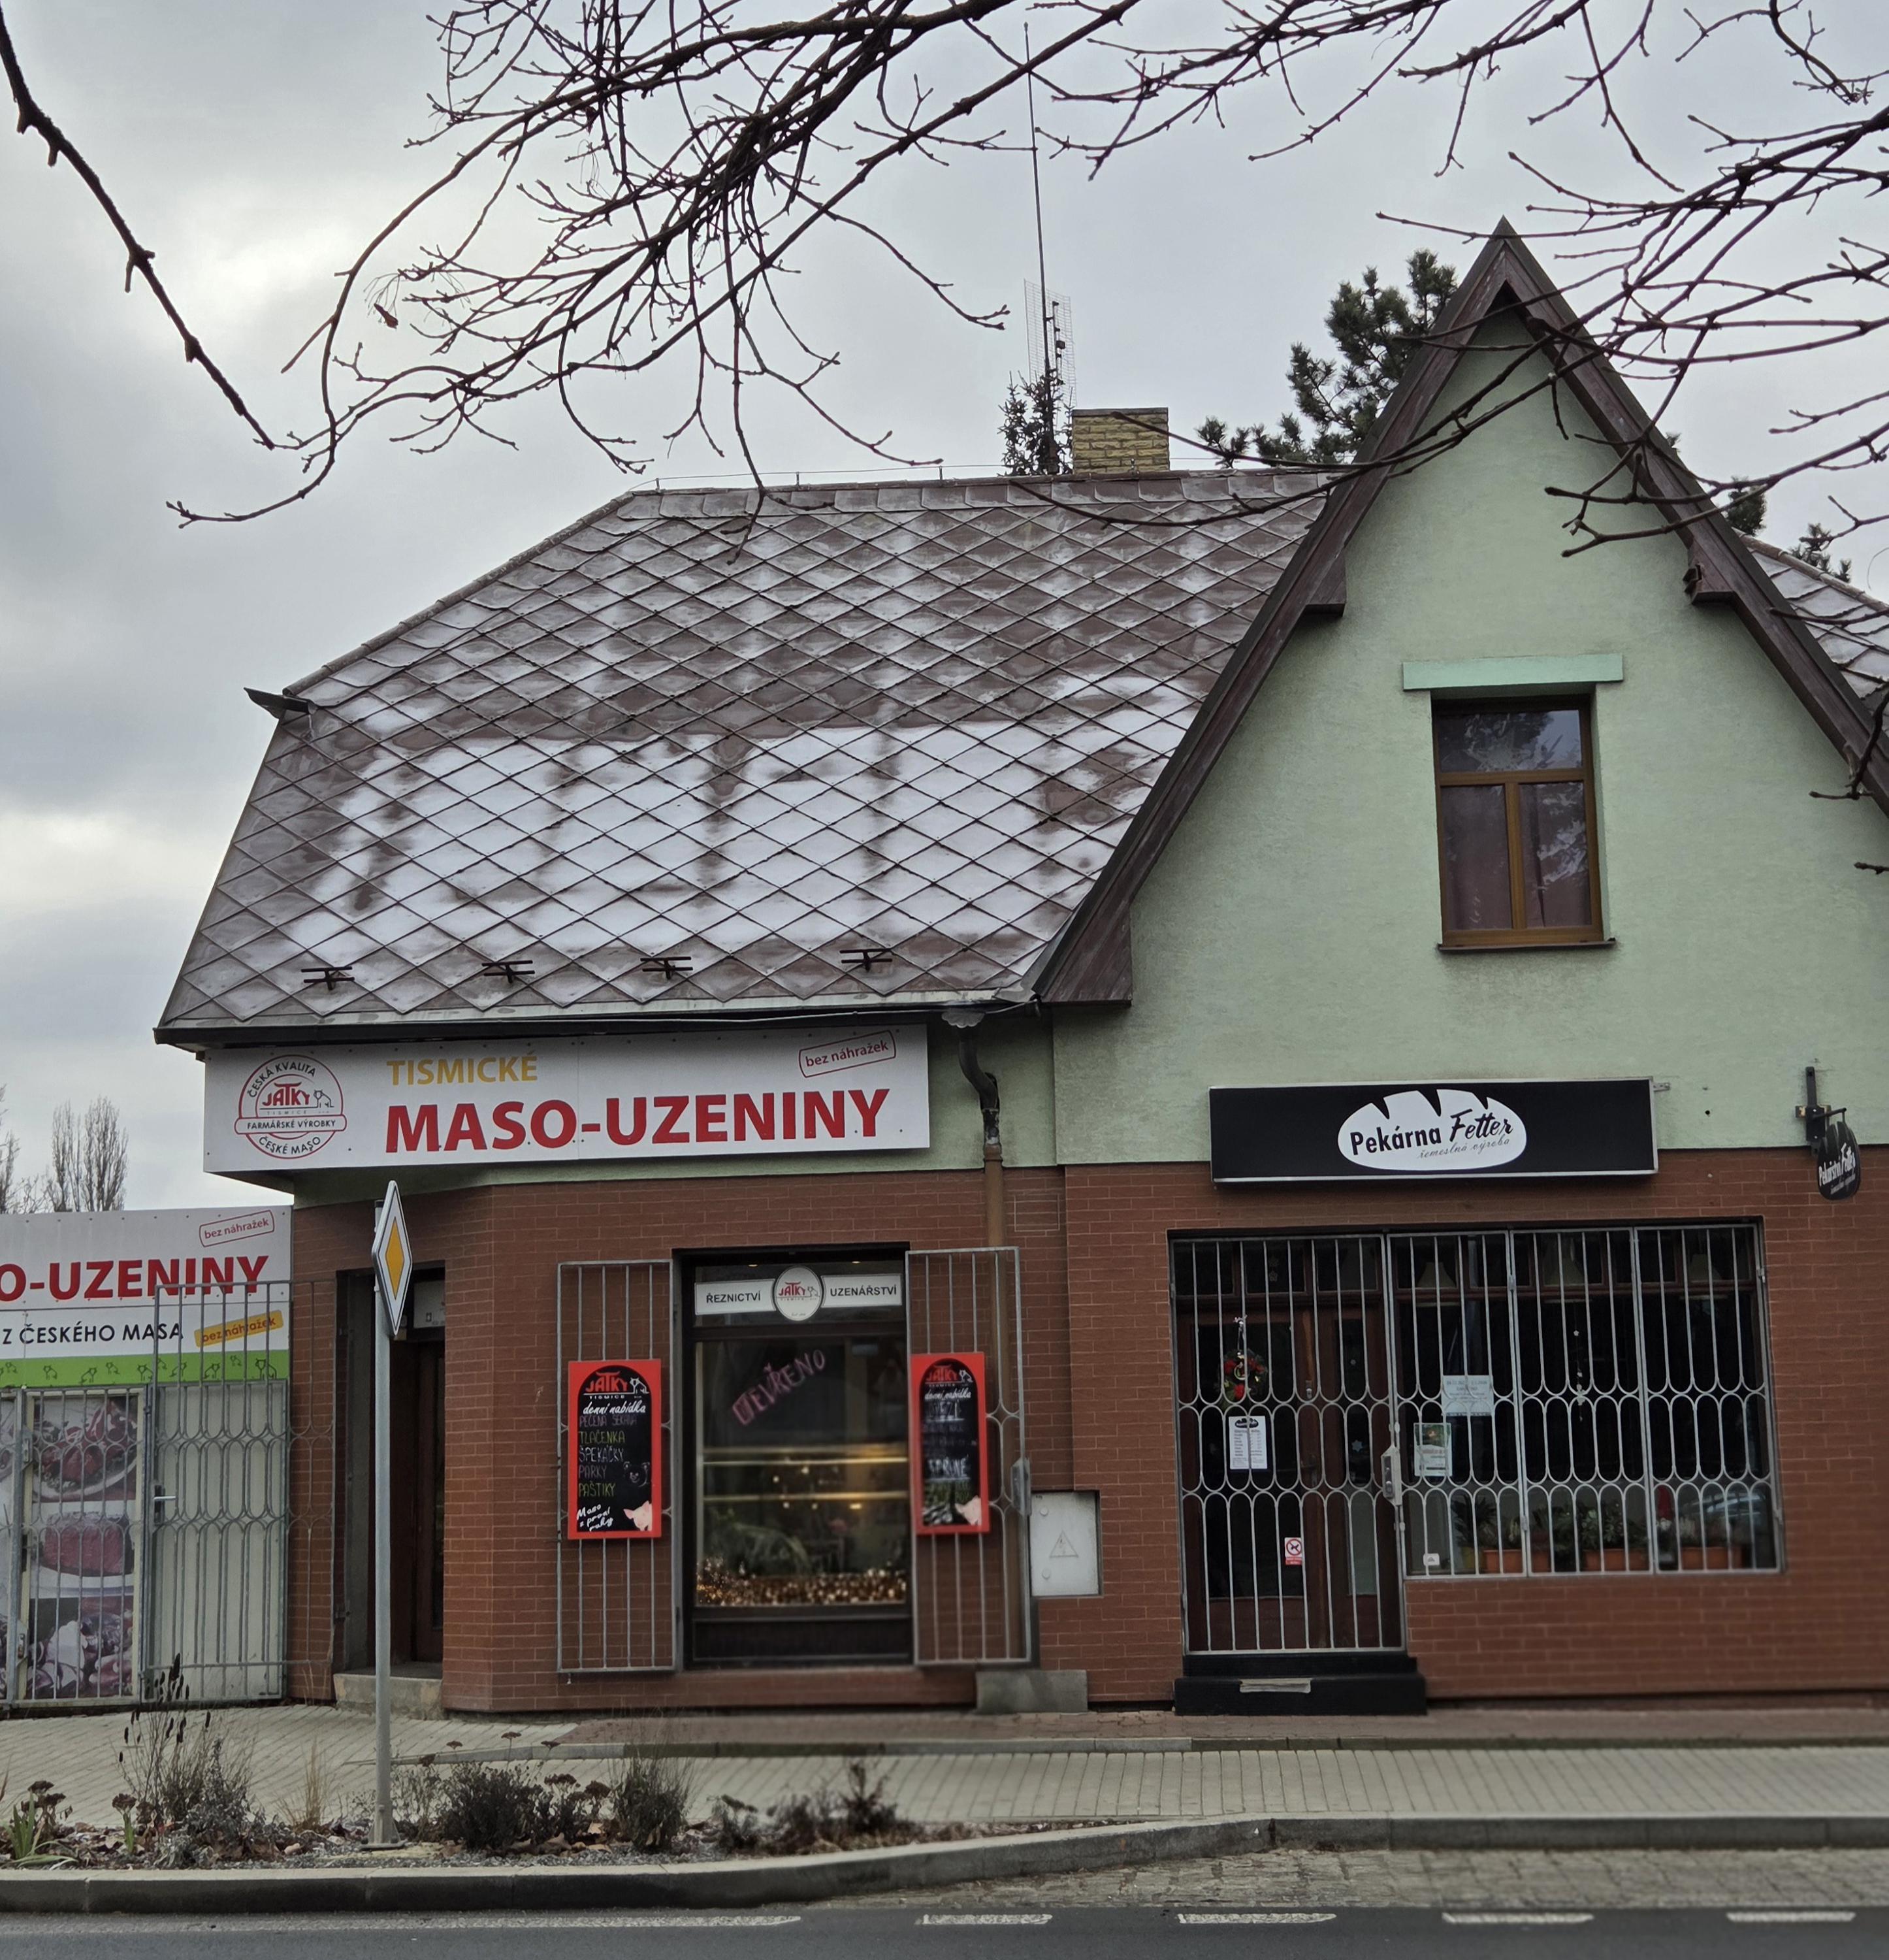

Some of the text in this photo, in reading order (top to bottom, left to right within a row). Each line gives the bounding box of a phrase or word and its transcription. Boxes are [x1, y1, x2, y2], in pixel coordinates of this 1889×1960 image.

[805, 1039, 889, 1068] bez náhražek
[386, 1049, 538, 1086] TISMICKÉ
[247, 1061, 317, 1098] ČESKÁ KVALITA
[262, 1082, 310, 1106] JATKY
[247, 1119, 336, 1130] FARMÁŘSKÉ VÝROBKY
[385, 1088, 890, 1154] MASO-UZENINY
[1349, 1108, 1514, 1156] Pekárna Fetter
[259, 1136, 321, 1154] ČESKÉ MASO
[1472, 1135, 1511, 1155] výroba
[204, 1218, 269, 1239] bez náhražek
[0, 1255, 268, 1301] O-UZENINY
[779, 1281, 805, 1296] JATKY
[705, 1290, 761, 1303] ŘEZNICTVÍ
[830, 1284, 897, 1297] UZENÁŘSTVÍ
[3, 1321, 184, 1345] Z ČESKÉHO MASA
[585, 1371, 628, 1392] JATKY
[583, 1399, 646, 1414] denní nabídka
[579, 1429, 626, 1445] TLAČENKA
